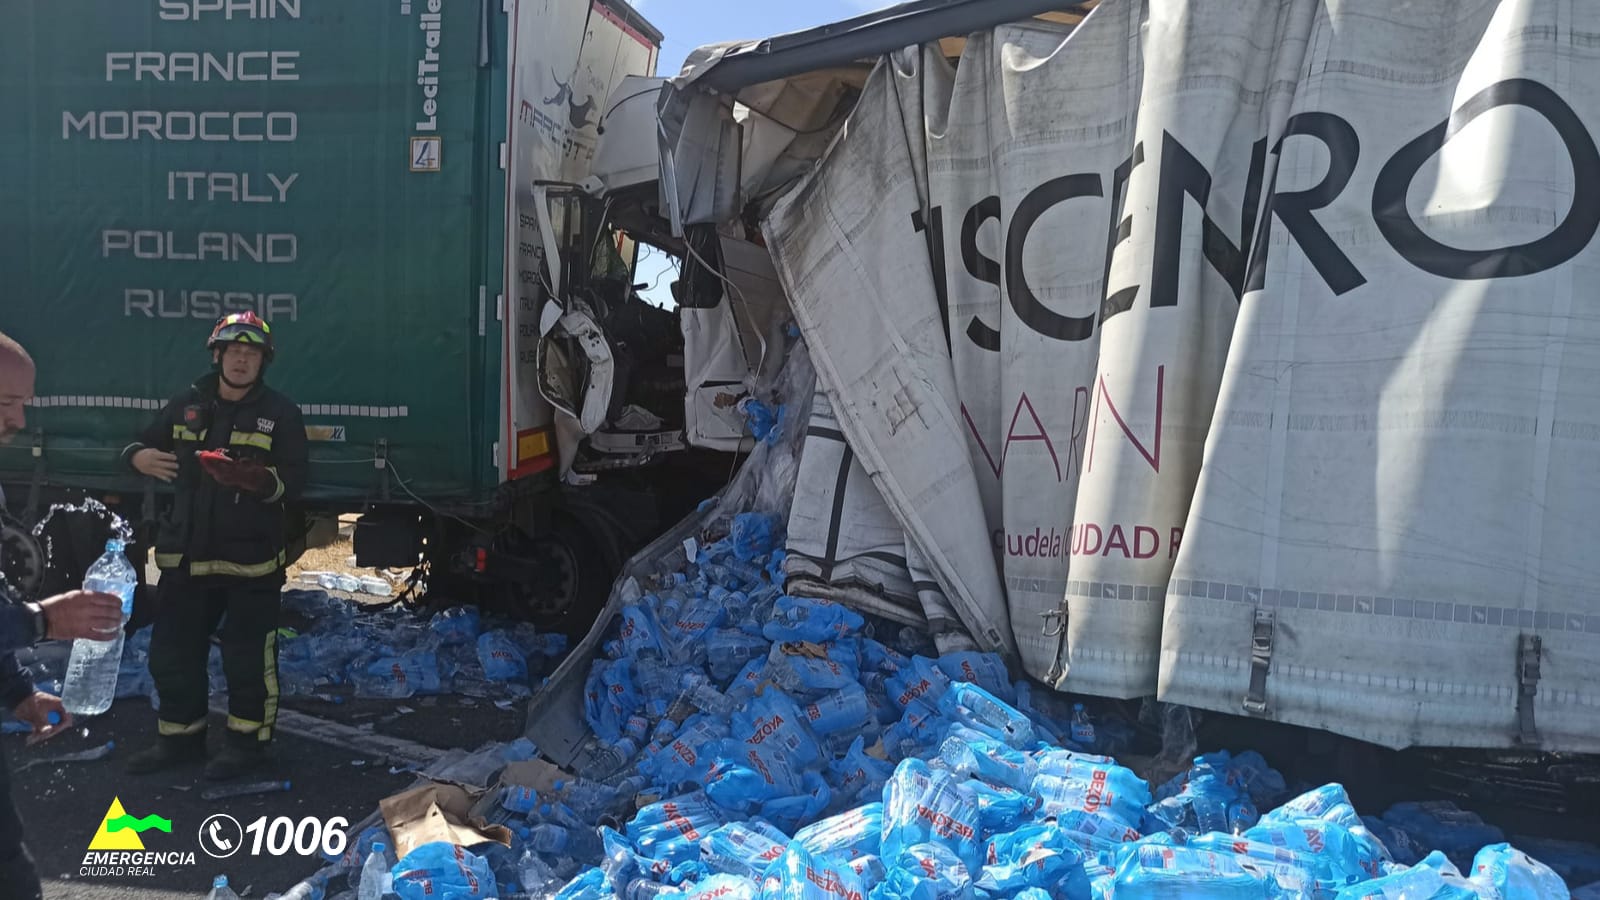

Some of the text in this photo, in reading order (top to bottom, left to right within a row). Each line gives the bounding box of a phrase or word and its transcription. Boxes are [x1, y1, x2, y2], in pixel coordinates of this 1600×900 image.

[159, 0, 300, 20] SPAIN
[106, 51, 300, 81] FRANCE
[62, 111, 298, 142] MOROCCO
[168, 171, 299, 203] ITALY
[102, 230, 297, 263] POLAND
[124, 288, 298, 322] RUSSIA
[1083, 770, 1106, 813] BEZOY
